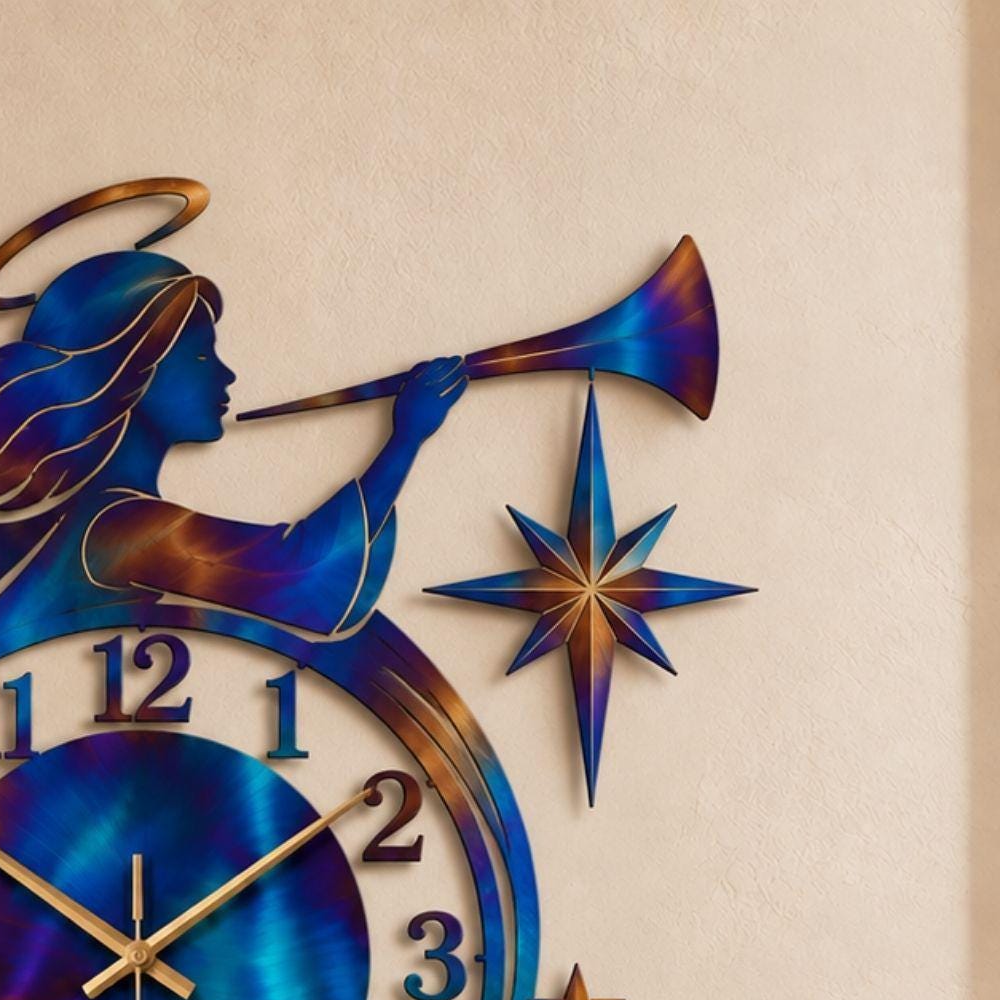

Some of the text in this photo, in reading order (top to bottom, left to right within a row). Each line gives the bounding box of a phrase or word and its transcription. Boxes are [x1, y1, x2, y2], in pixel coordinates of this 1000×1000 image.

[93, 633, 193, 723] 12
[265, 669, 309, 759] 1
[361, 770, 425, 862] 2
